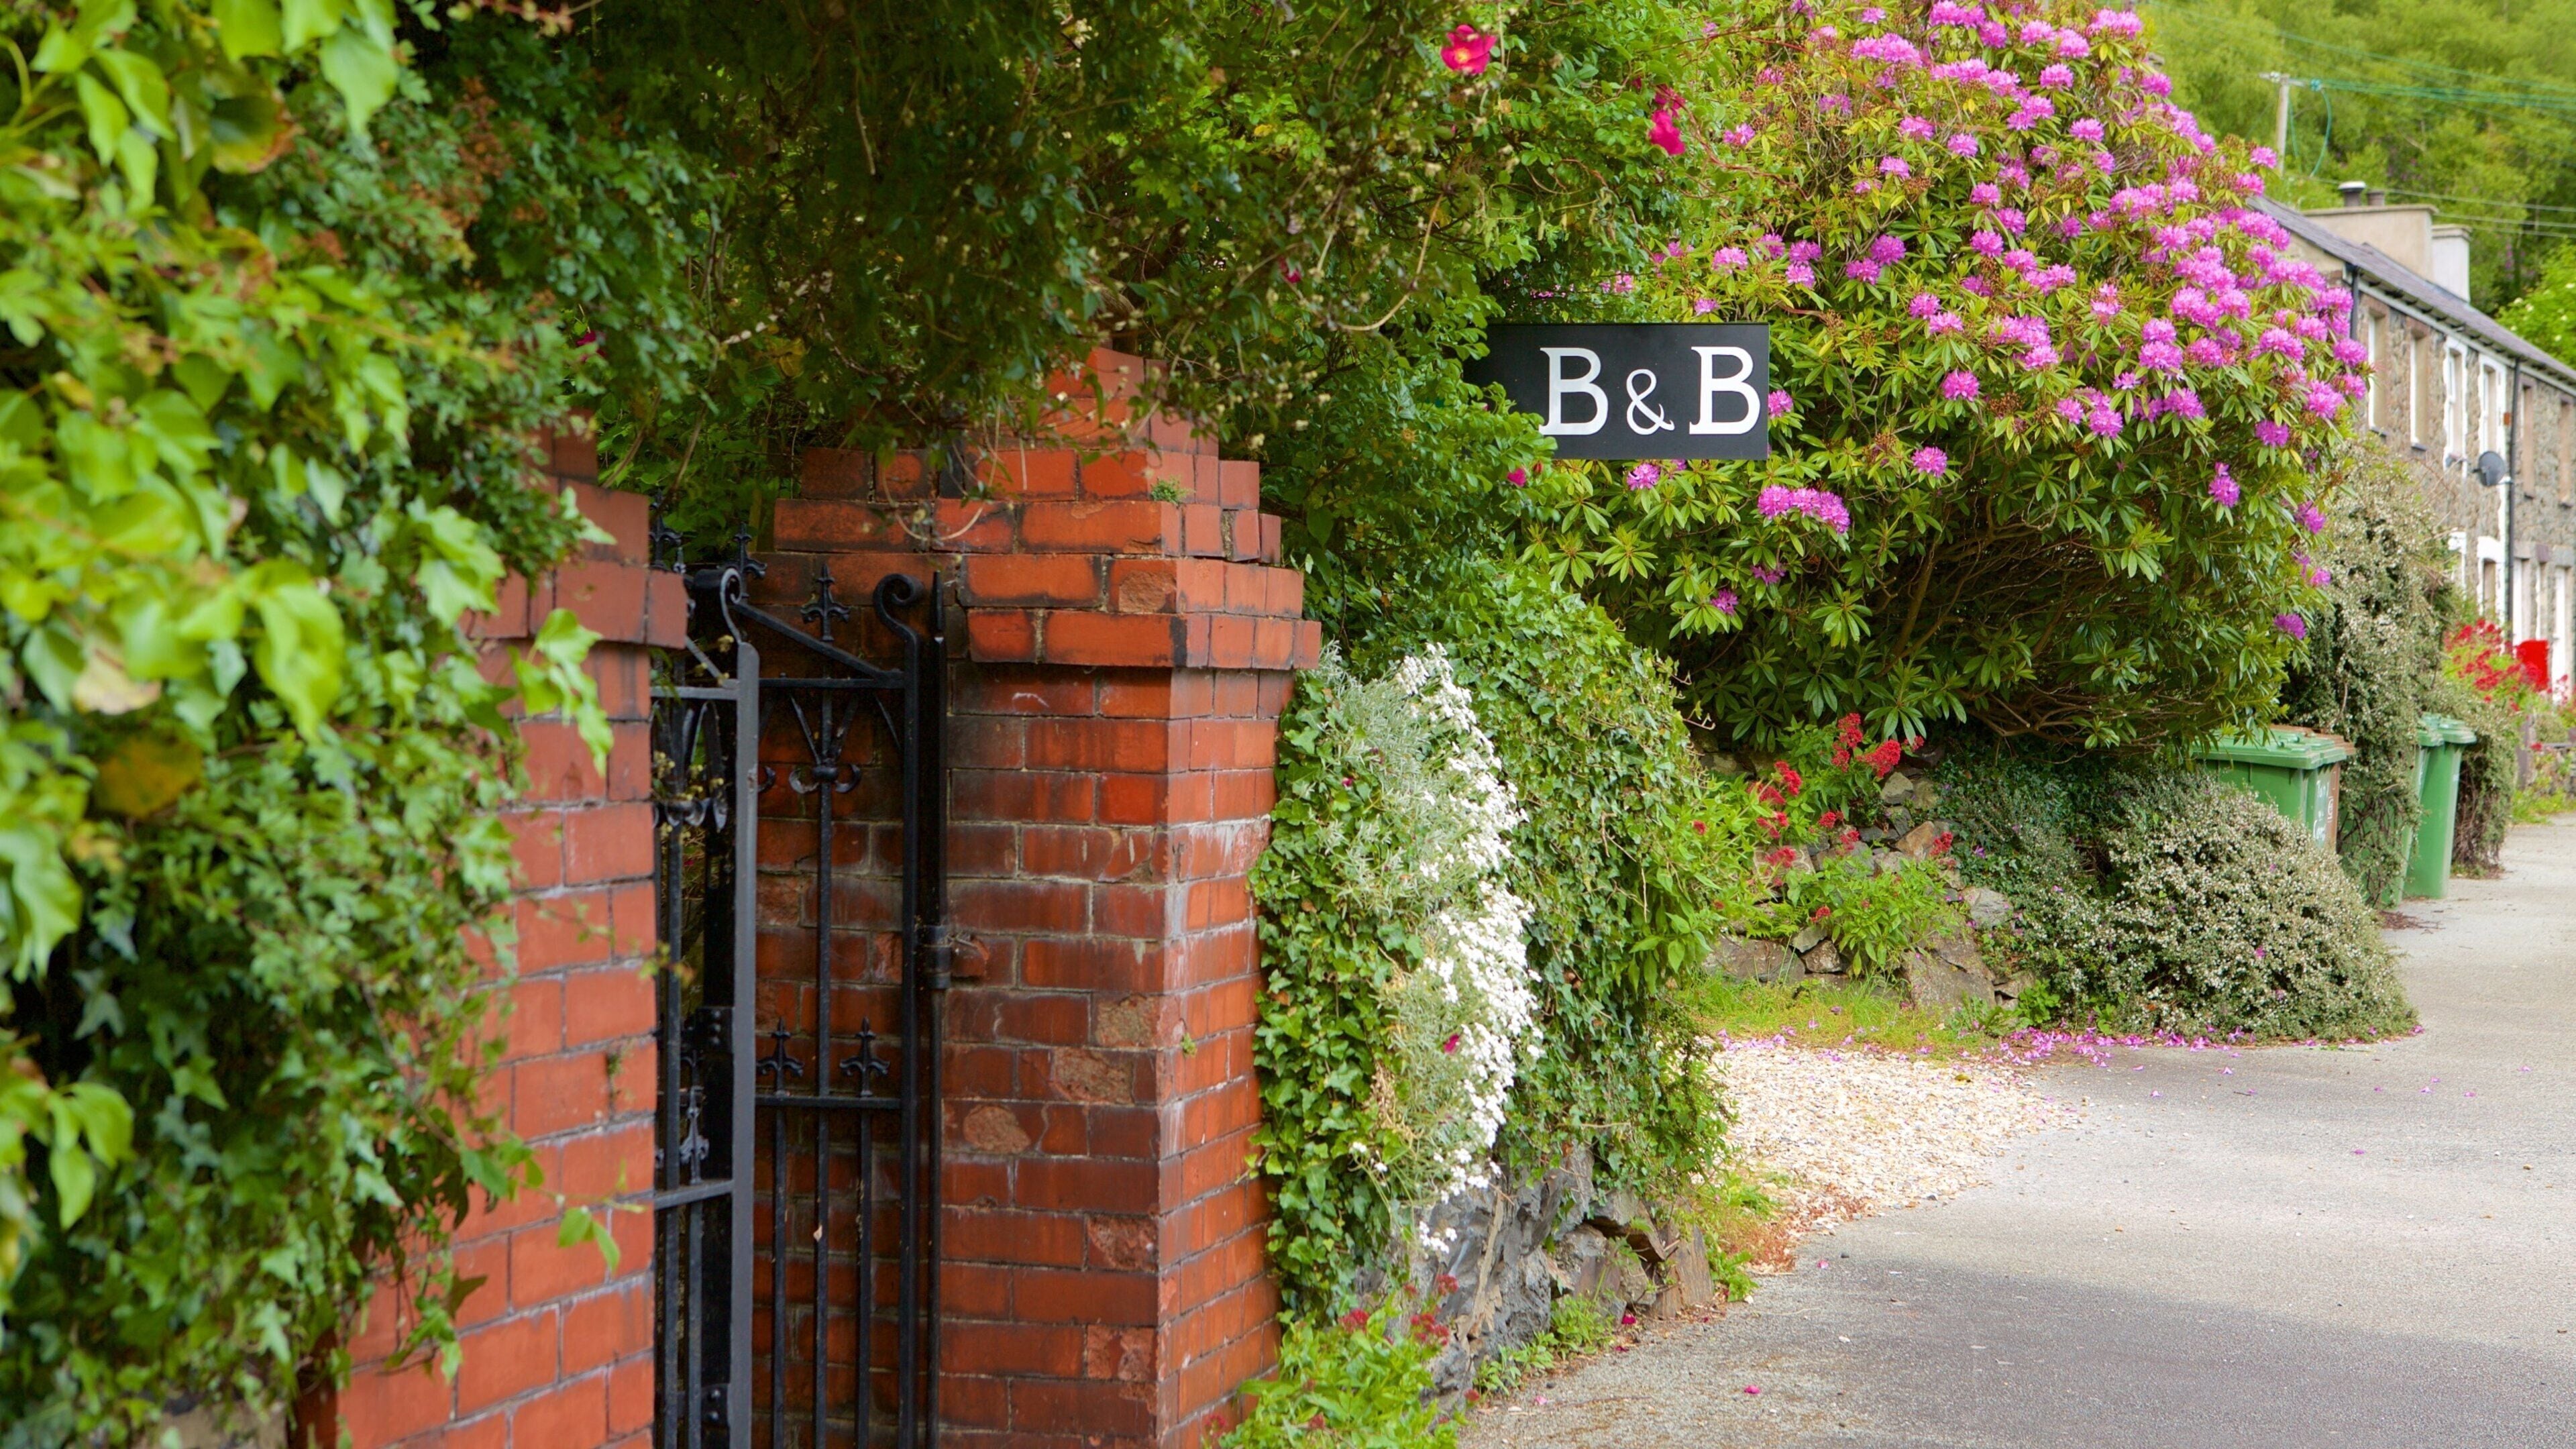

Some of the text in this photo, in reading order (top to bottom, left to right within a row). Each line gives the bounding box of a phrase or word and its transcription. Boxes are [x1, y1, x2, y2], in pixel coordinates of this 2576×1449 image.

[1539, 346, 1761, 435] B & B
